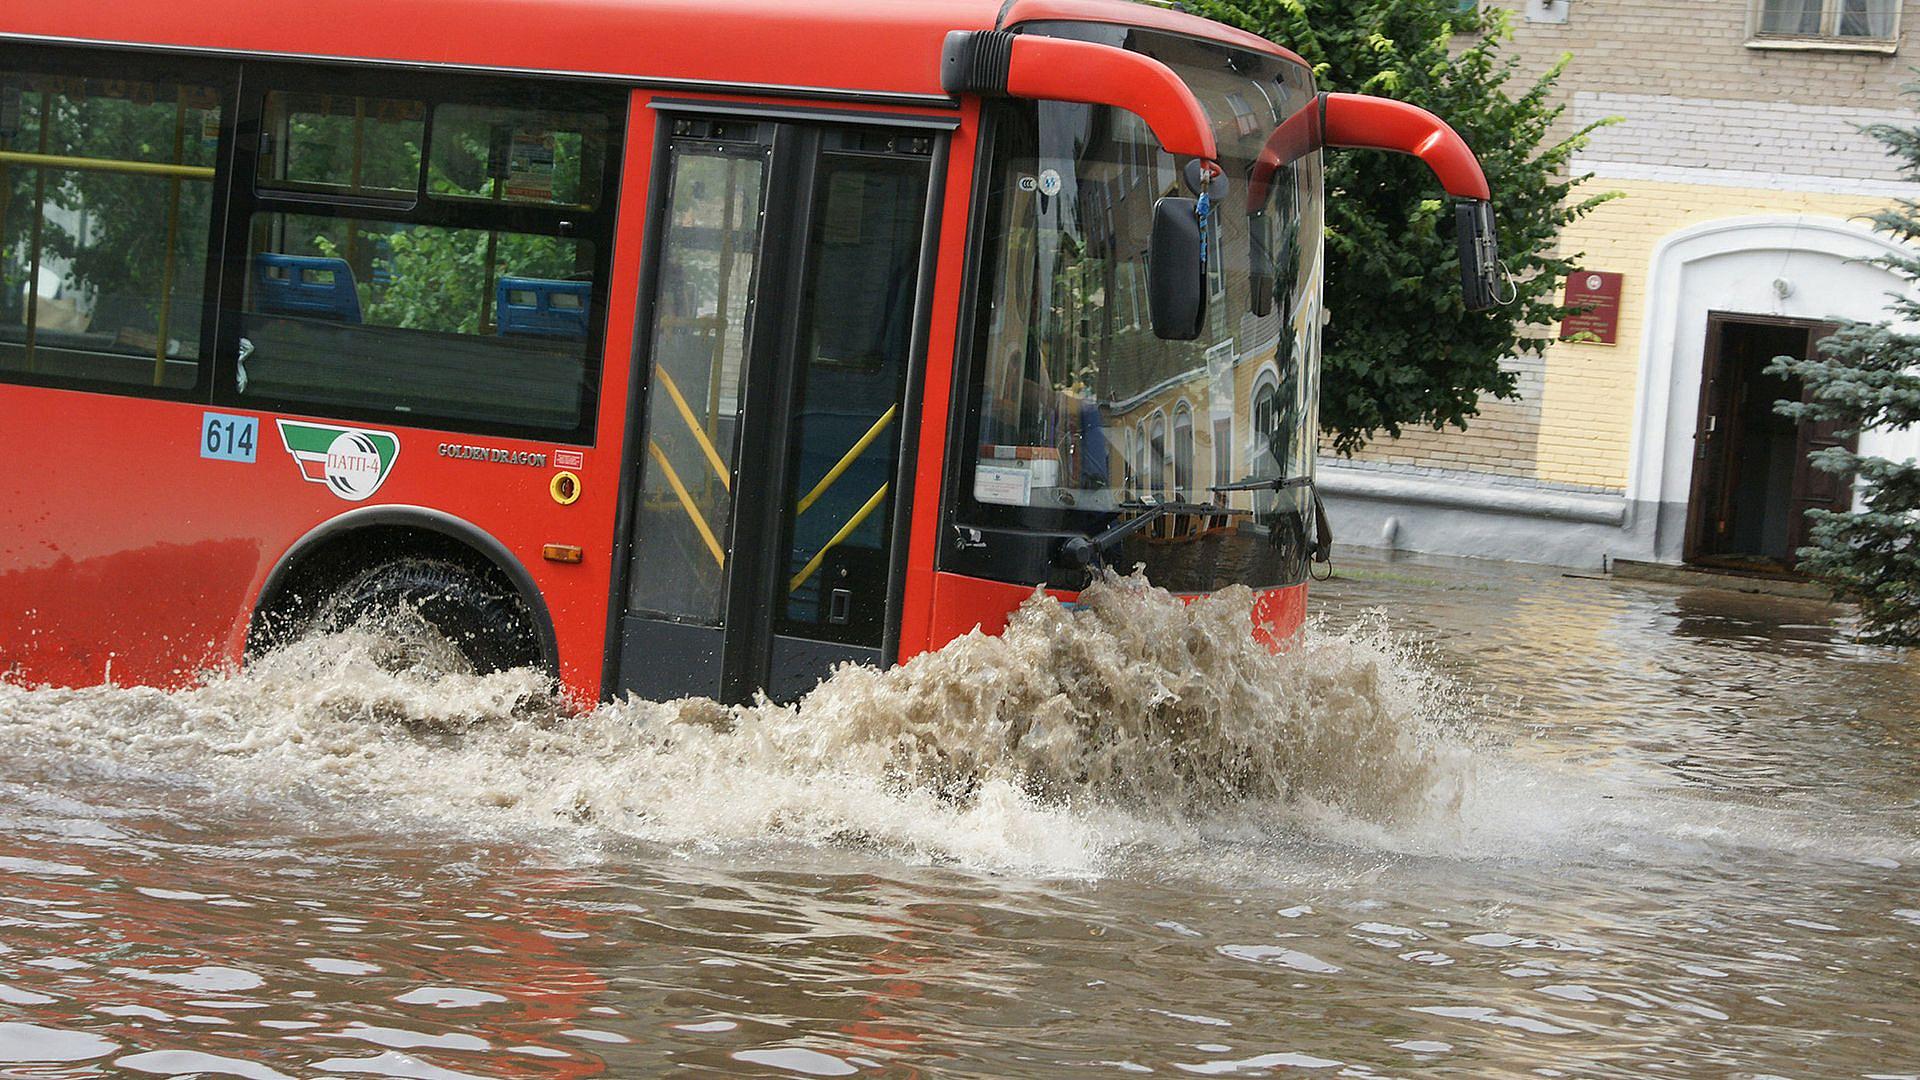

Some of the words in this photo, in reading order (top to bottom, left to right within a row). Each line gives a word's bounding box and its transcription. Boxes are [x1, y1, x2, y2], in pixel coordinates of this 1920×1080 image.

[207, 419, 253, 456] 614
[327, 453, 379, 473] ПАТП-4
[438, 443, 490, 462] GOLDEN
[490, 448, 547, 467] DRAGON
